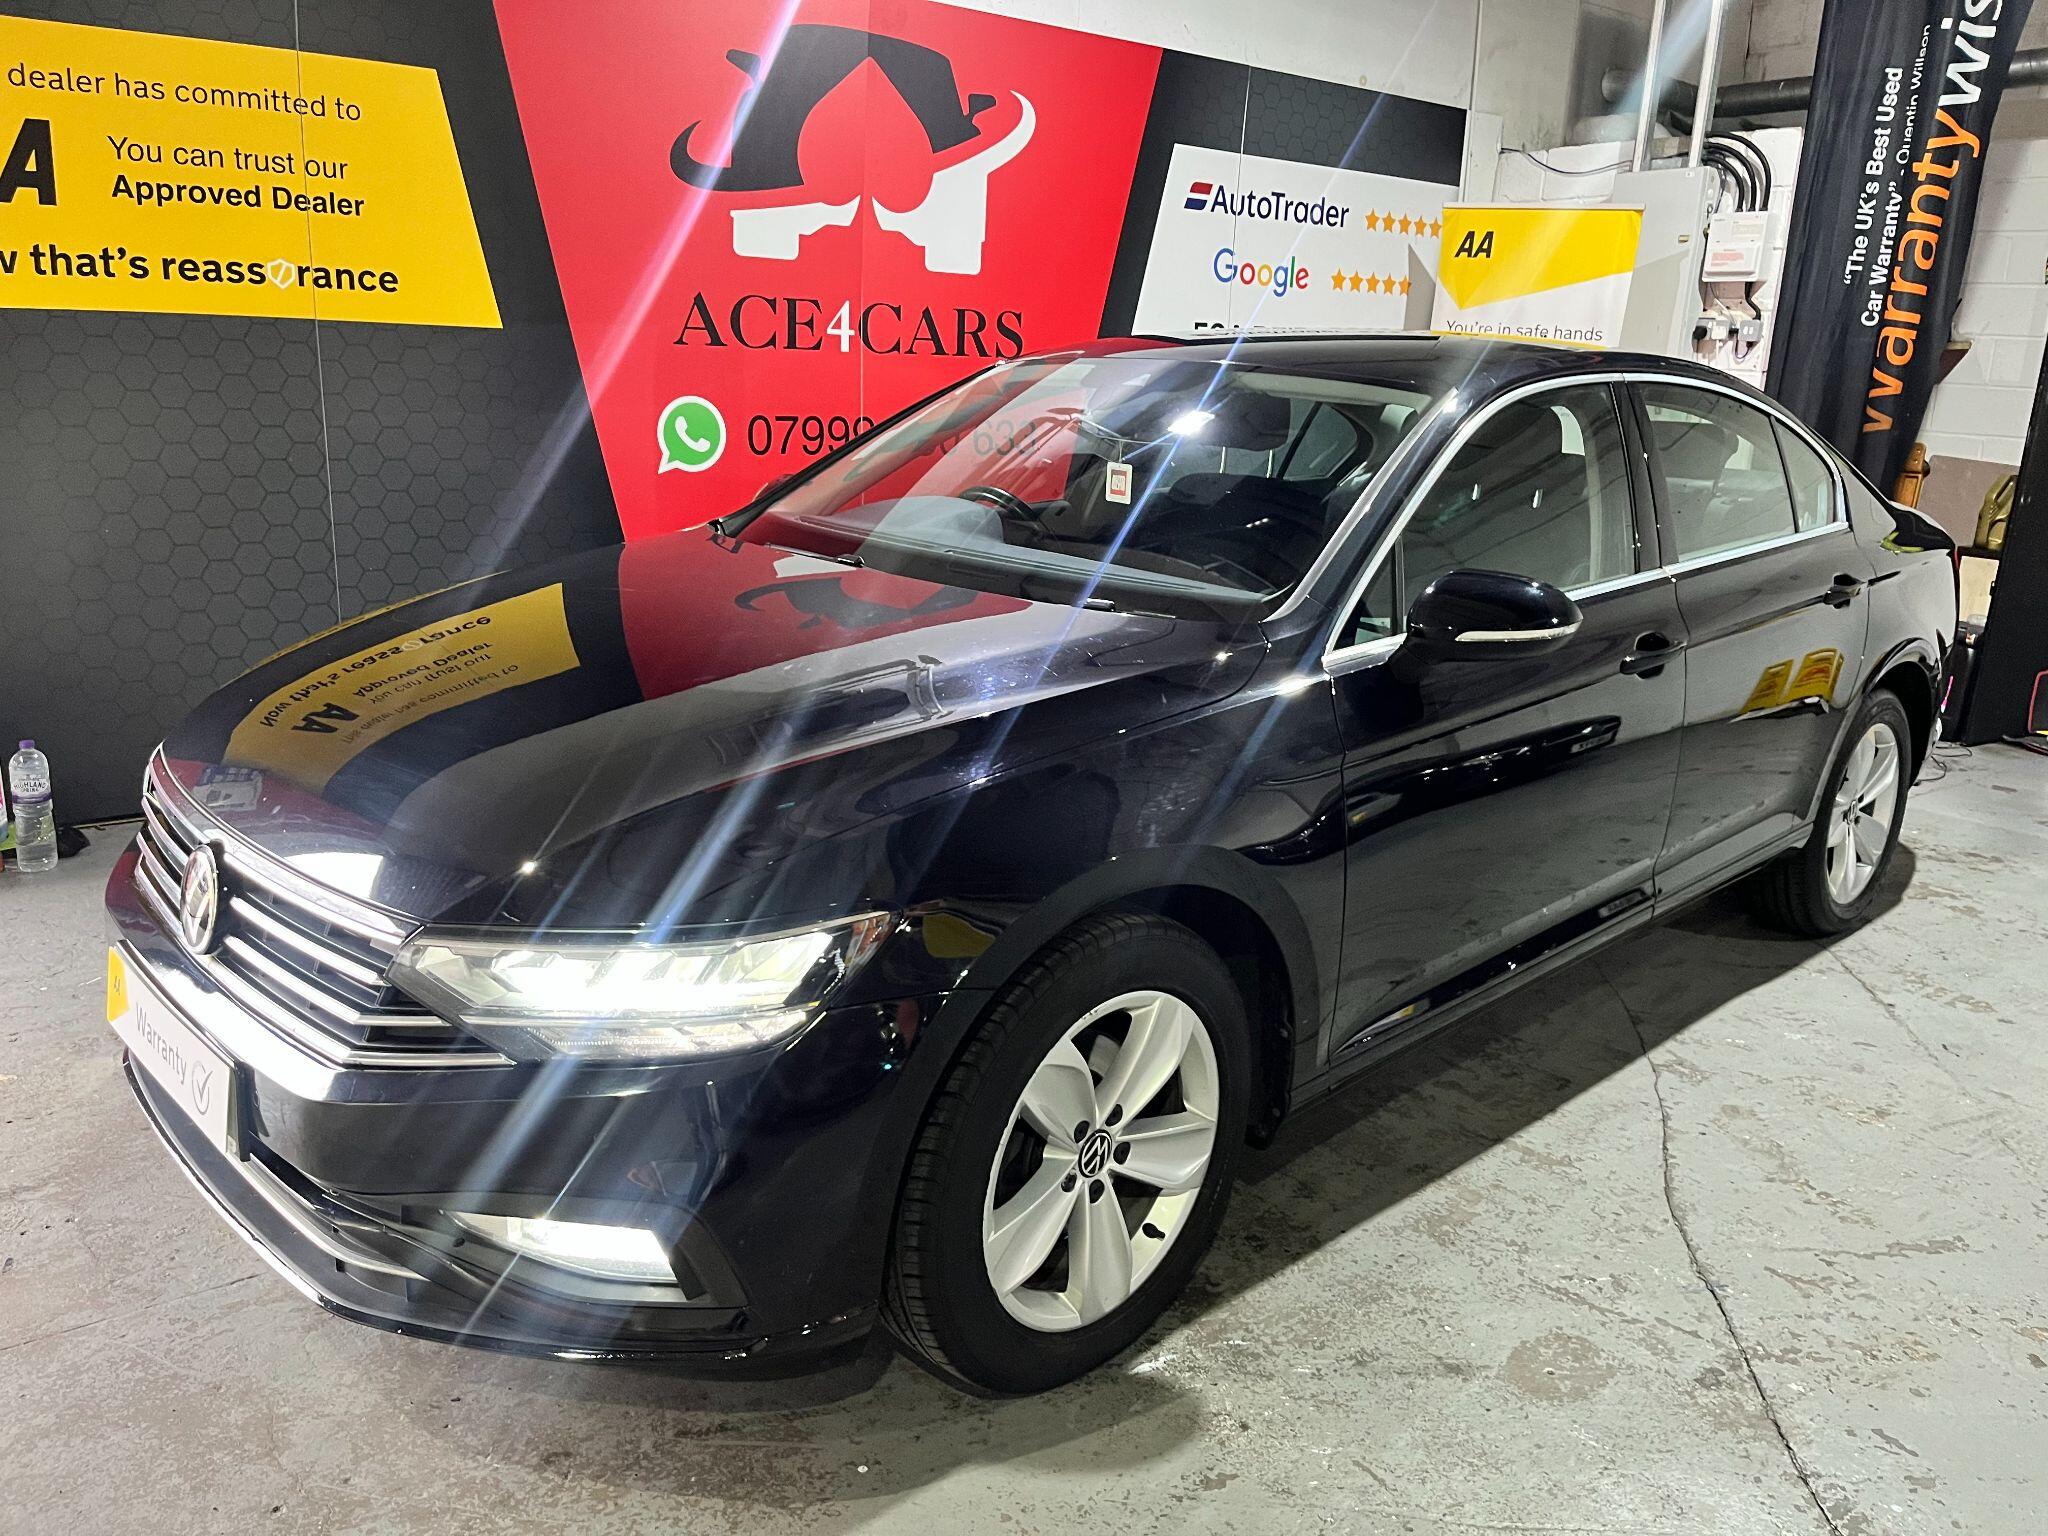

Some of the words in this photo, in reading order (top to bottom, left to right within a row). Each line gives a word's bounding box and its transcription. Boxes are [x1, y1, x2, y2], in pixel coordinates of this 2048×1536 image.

[8, 62, 105, 94] dealer
[114, 72, 165, 100] has
[175, 83, 326, 118] committed
[335, 98, 362, 121] to
[1876, 67, 1903, 122] Used
[107, 135, 162, 164] You
[173, 145, 225, 168] can
[234, 148, 295, 175] trust
[304, 157, 348, 180] our
[1865, 127, 1891, 176] Best
[111, 175, 262, 208] Approved
[272, 186, 365, 216] Dealer
[1211, 185, 1350, 228] AutoTrader
[30, 244, 150, 279] that’s
[1454, 230, 1495, 259] AA
[1213, 247, 1309, 298] Google
[673, 292, 1024, 360] ACE4CARS
[1860, 290, 1884, 327] Car
[1498, 322, 1511, 335] in
[1516, 324, 1549, 337] safe
[1553, 325, 1603, 341] hands
[136, 1003, 187, 1085] Warranty
